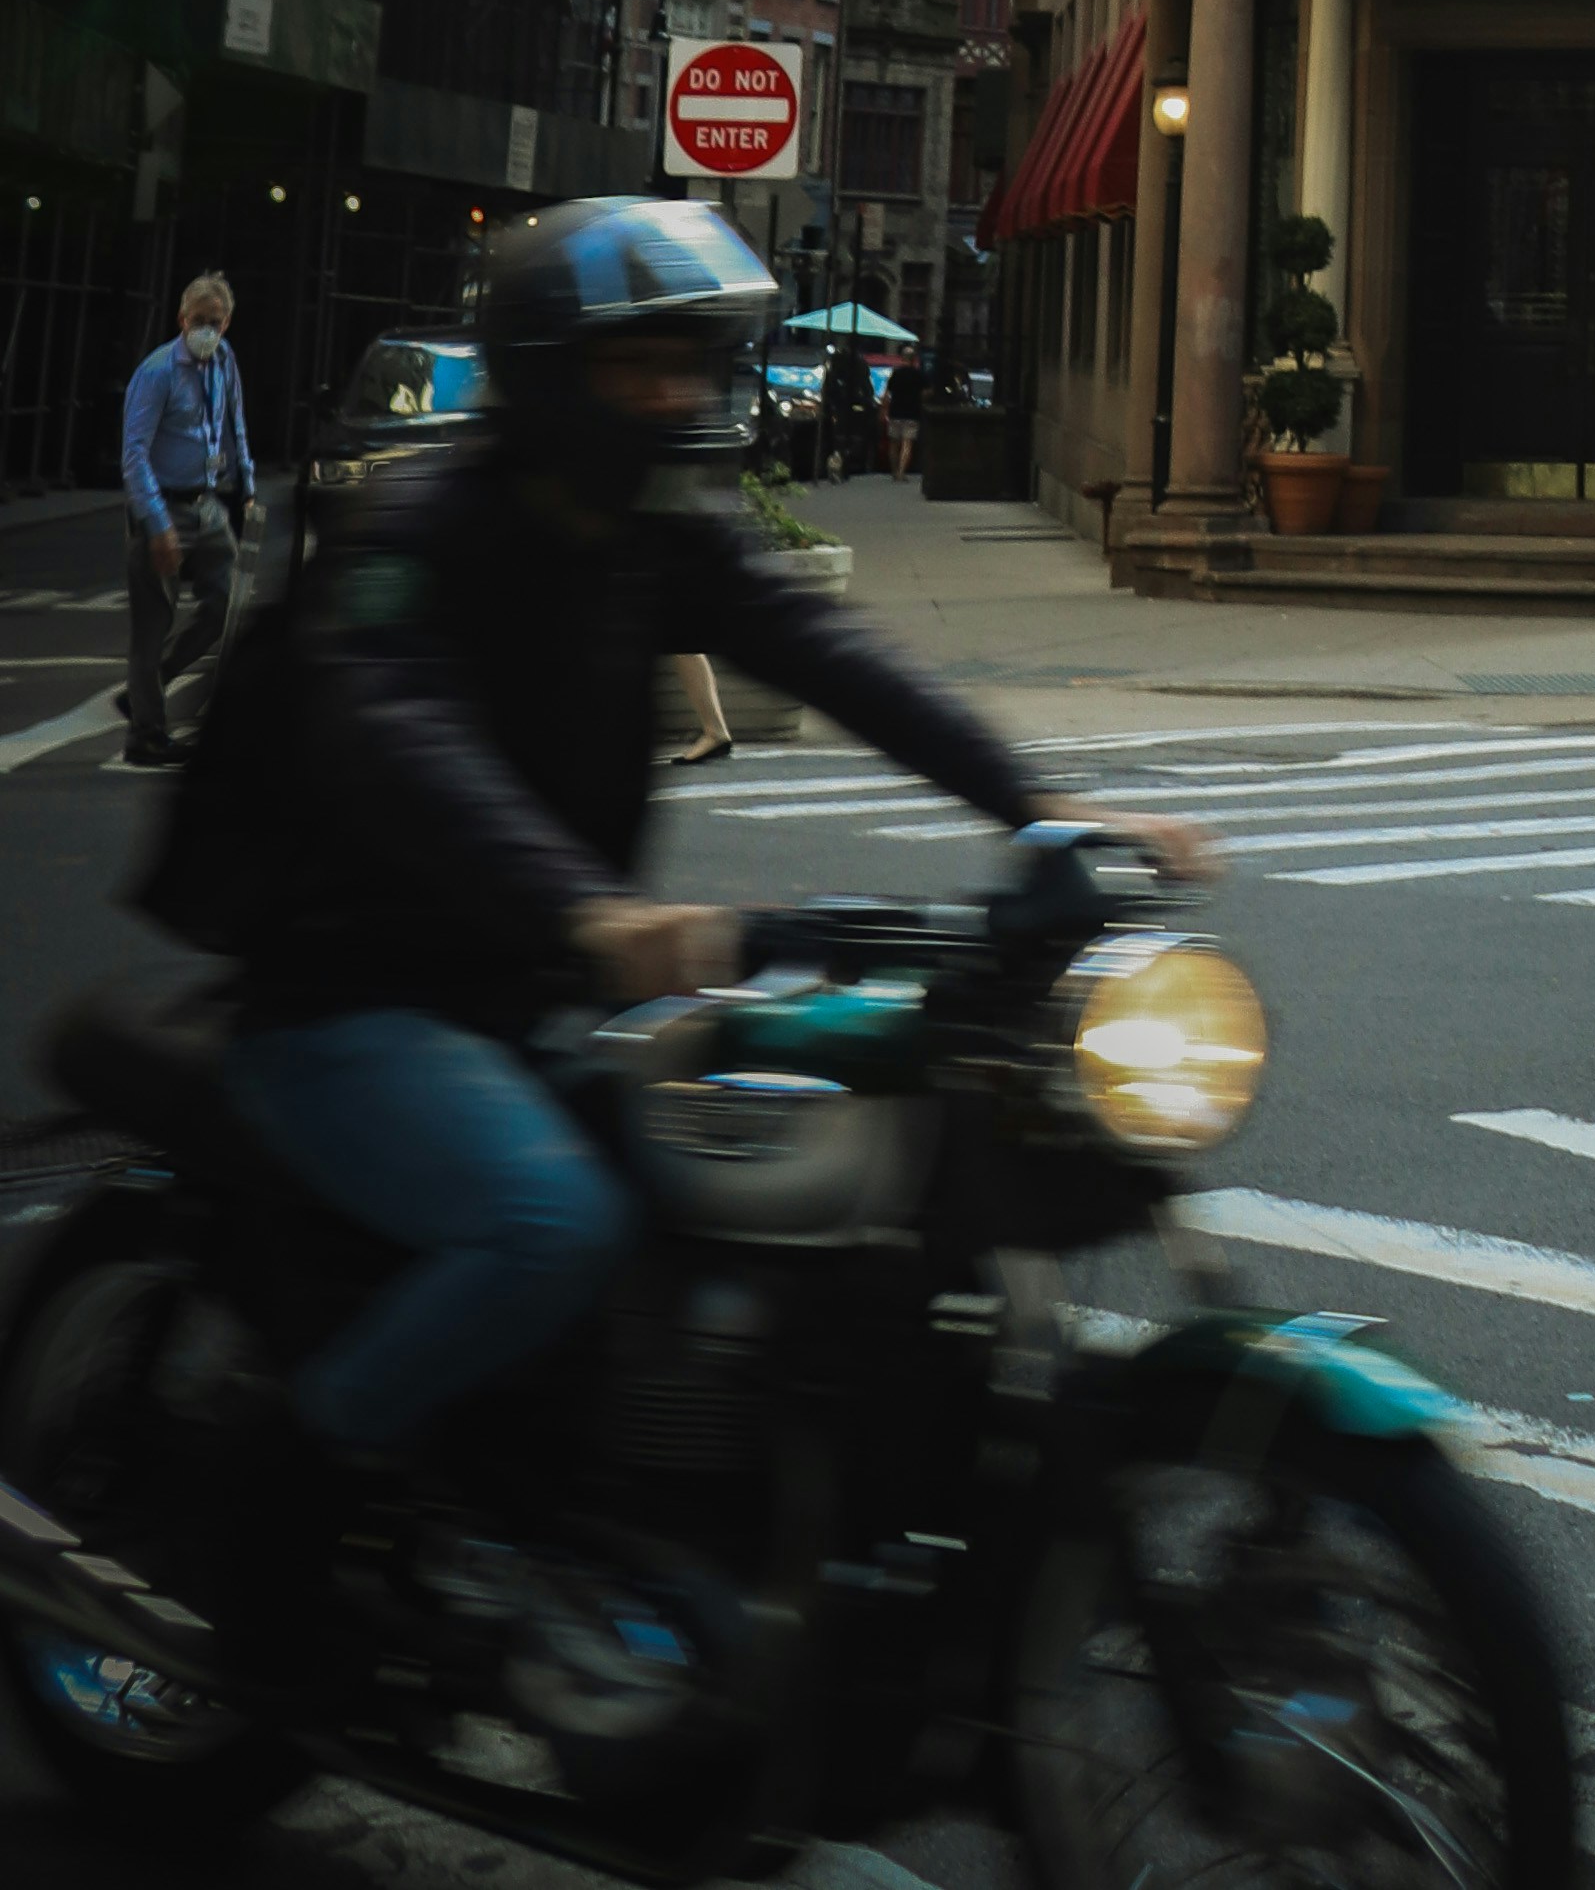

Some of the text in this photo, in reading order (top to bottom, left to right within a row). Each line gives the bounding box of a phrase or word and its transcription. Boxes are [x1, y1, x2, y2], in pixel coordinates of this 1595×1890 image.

[688, 68, 780, 92] DO NOT
[695, 126, 769, 150] ENTER
